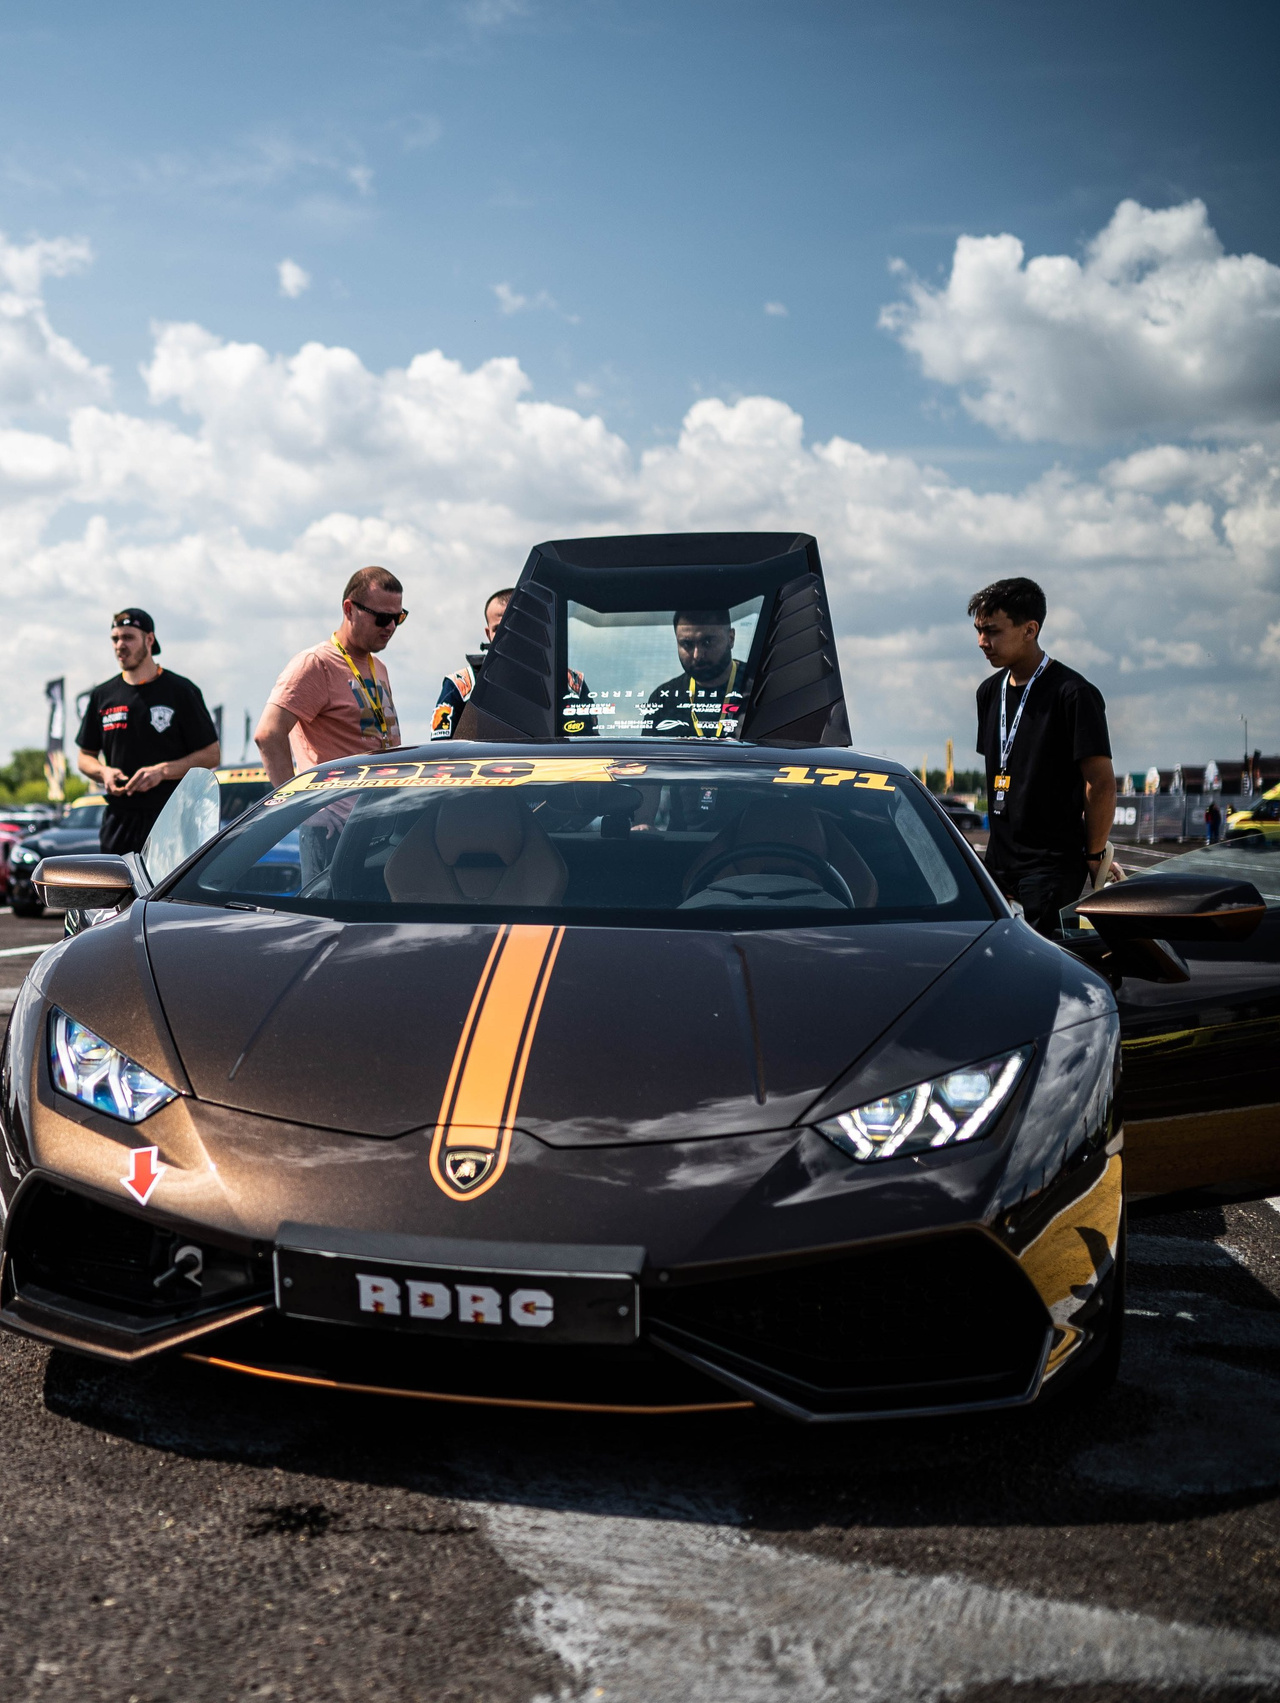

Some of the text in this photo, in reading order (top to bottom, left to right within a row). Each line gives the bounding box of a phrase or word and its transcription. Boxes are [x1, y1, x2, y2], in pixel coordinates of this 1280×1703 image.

[588, 690, 718, 698] FELIX FERRO
[311, 761, 536, 783] RDRC
[773, 766, 895, 791] 171
[305, 777, 516, 790] GOSHATURBOTECH
[354, 1272, 554, 1328] RDRC
